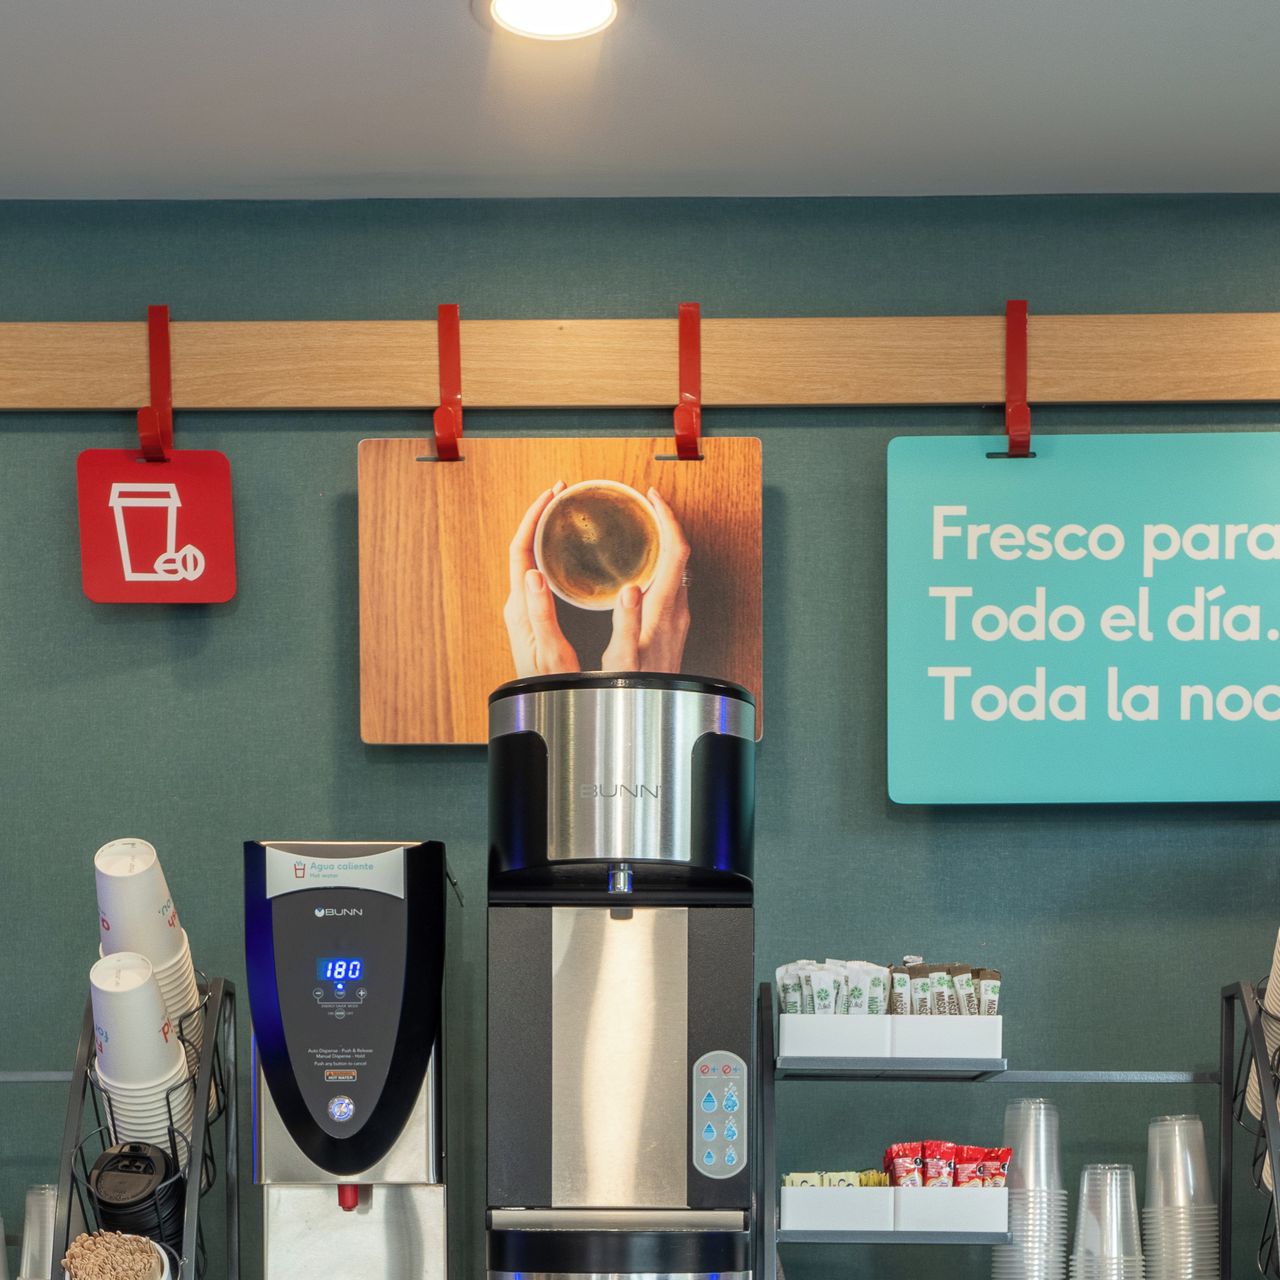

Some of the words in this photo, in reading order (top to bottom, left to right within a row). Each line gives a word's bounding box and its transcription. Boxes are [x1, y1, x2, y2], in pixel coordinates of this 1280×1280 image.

[932, 505, 1125, 561] Fresco
[928, 586, 1085, 642] Todo
[1100, 586, 1154, 642] el
[1167, 585, 1280, 642] día.
[927, 666, 1086, 722] Toda
[1107, 666, 1159, 722] la
[580, 784, 661, 799] BUNN
[310, 862, 335, 871] Agua
[336, 862, 374, 870] caliente
[325, 908, 363, 916] BUNN
[326, 961, 361, 979] 180
